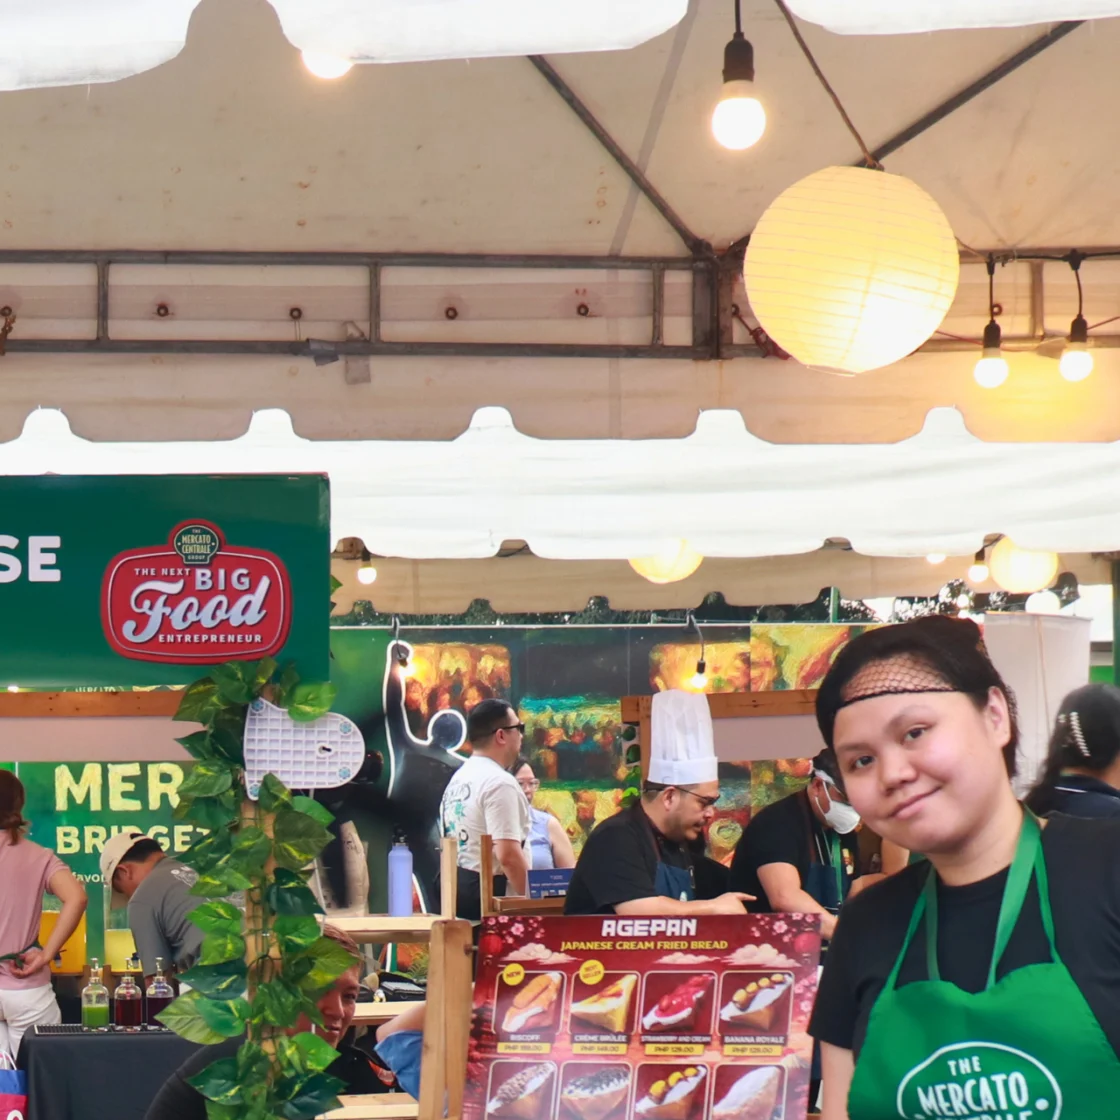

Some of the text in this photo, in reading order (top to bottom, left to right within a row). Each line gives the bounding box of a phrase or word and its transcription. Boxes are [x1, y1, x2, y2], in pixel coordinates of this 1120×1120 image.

[182, 535, 211, 544] MERCATO
[182, 544, 211, 554] CENTRALE
[134, 567, 250, 591] THE NEXT BIG
[122, 575, 271, 643] Food
[158, 633, 263, 643] ENTREPRENEUR
[601, 918, 698, 937] AGEPAN
[561, 940, 729, 951] JAPANESE CREAM FRIED BREAD
[756, 1036, 785, 1044] ROYALE
[947, 1056, 981, 1076] THE
[917, 1071, 1029, 1116] MERCATO
